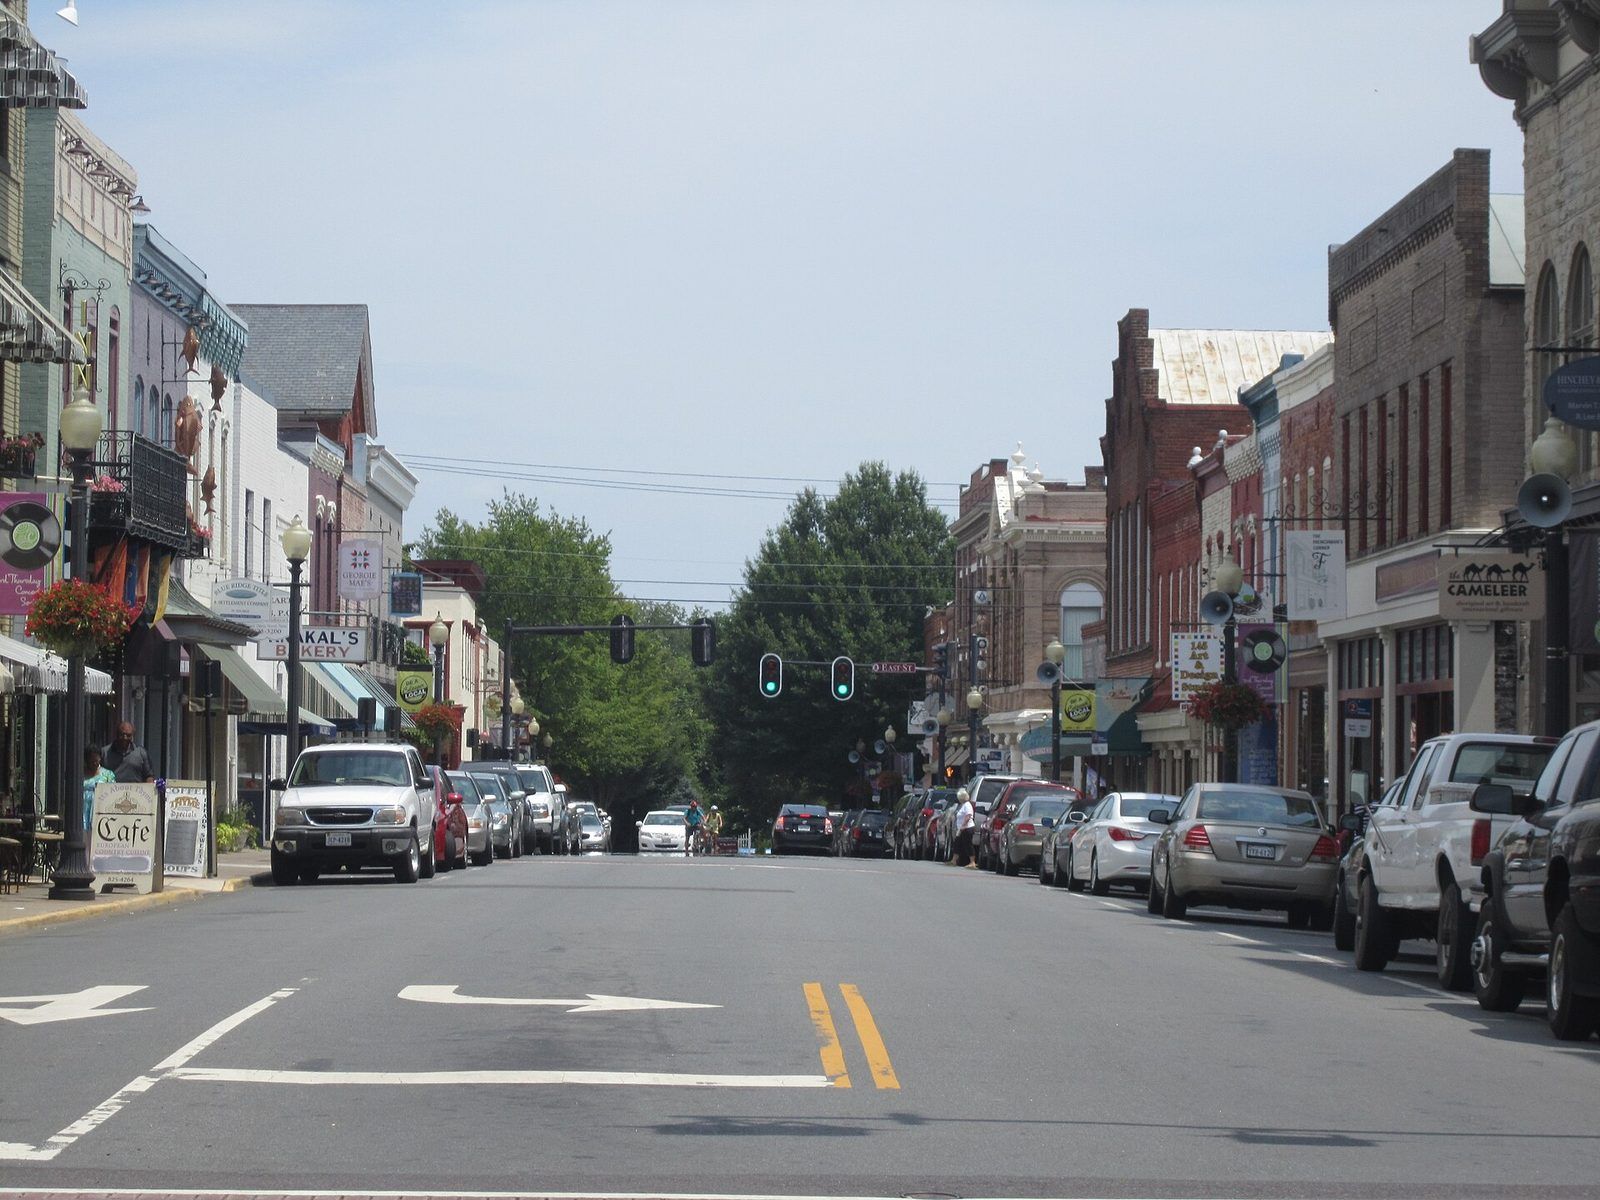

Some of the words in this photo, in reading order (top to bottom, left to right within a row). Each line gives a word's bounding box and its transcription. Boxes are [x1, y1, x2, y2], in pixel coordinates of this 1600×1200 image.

[252, 584, 269, 597] TITLE
[1447, 584, 1527, 596] CAMELEER
[276, 645, 350, 658] BKERY
[1189, 651, 1209, 660] Art
[1180, 670, 1219, 680] Design
[404, 688, 426, 699] LOCAL
[1069, 706, 1091, 718] LOCAL
[110, 784, 132, 793] About
[98, 817, 150, 848] Cafe
